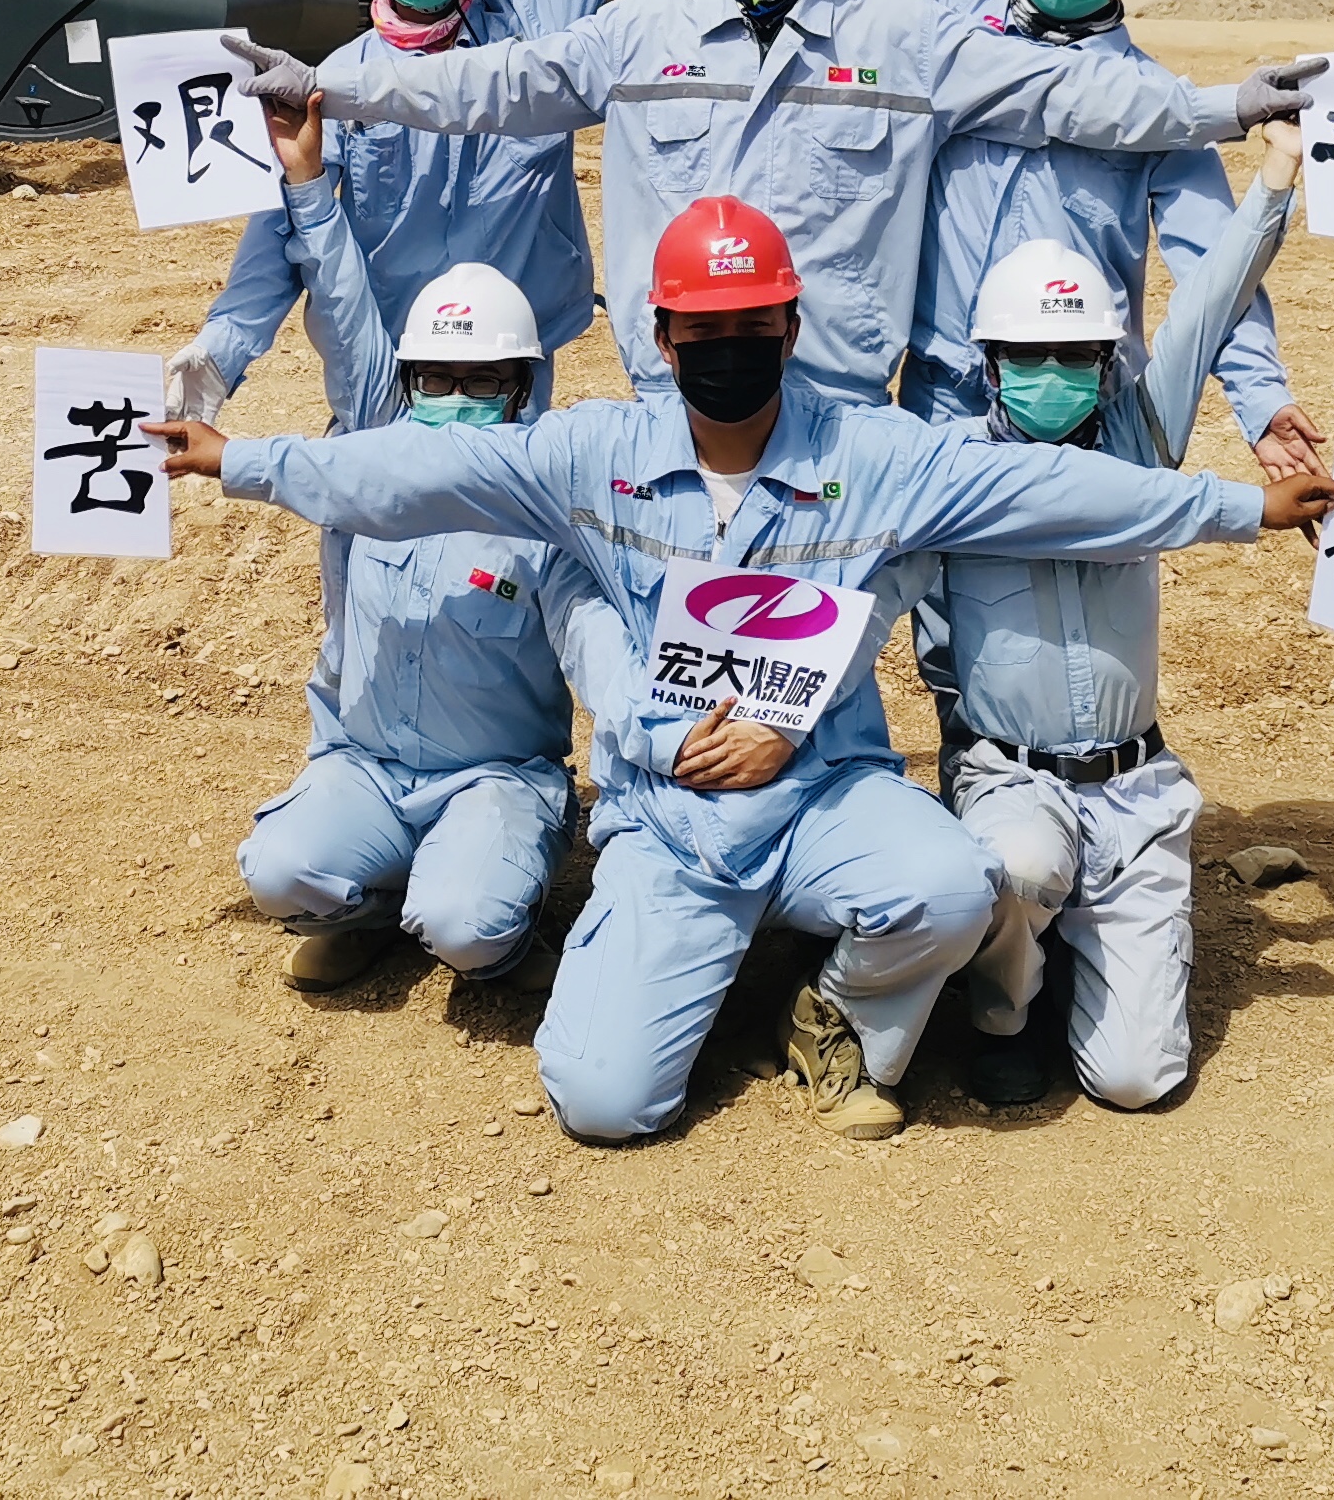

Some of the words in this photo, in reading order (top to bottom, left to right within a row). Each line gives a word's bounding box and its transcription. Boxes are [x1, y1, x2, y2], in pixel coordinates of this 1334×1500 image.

[132, 72, 272, 184] 艰
[43, 397, 154, 514] 苦
[651, 687, 730, 717] HANDA
[734, 705, 804, 726] BLASTING
[654, 642, 827, 708] 宏大爆破
